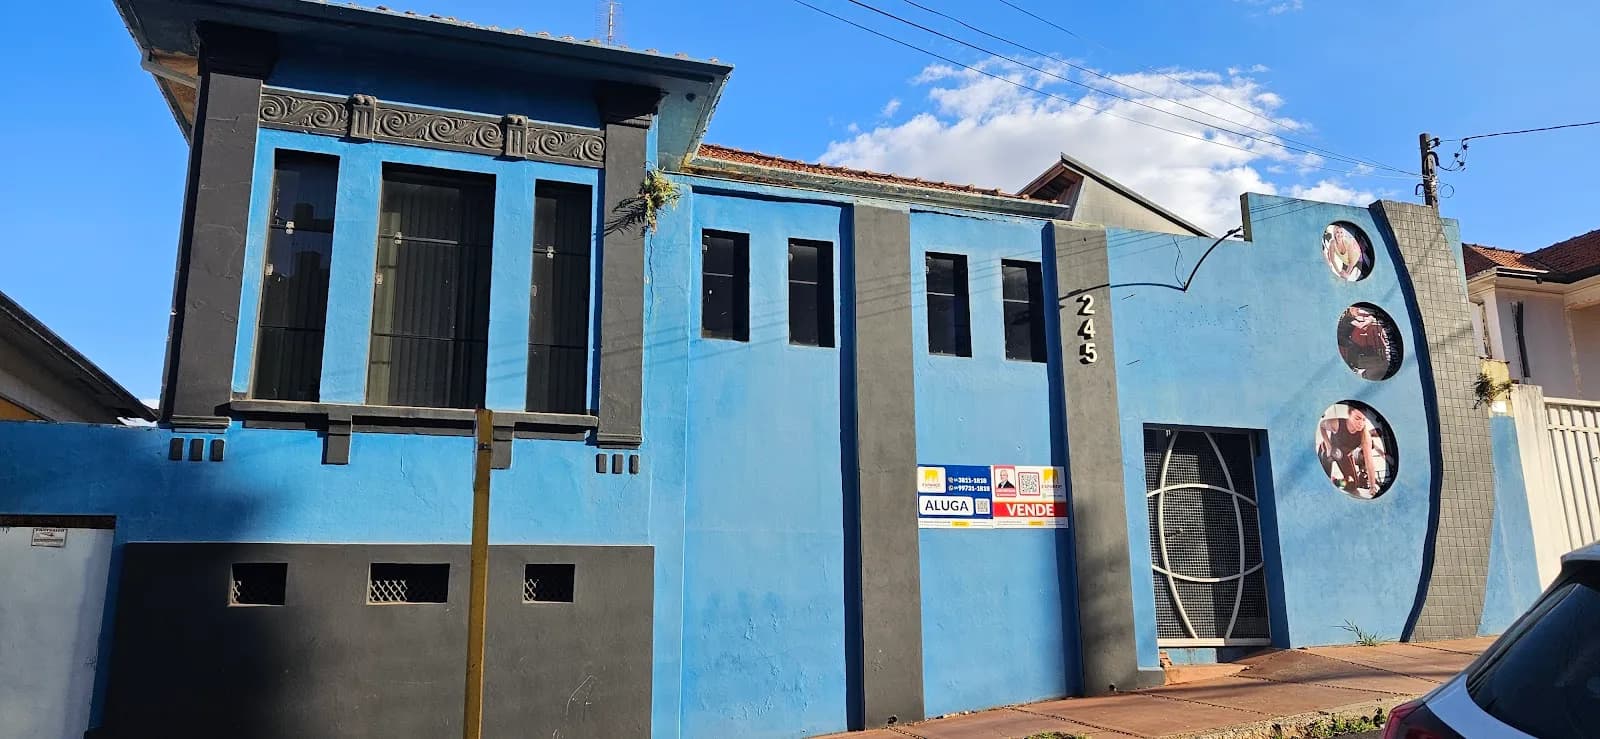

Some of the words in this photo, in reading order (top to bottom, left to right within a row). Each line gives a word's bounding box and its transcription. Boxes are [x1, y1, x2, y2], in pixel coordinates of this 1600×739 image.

[1082, 294, 1098, 363] 245
[925, 499, 969, 511] ALUGA
[1006, 503, 1055, 517] VENDE
